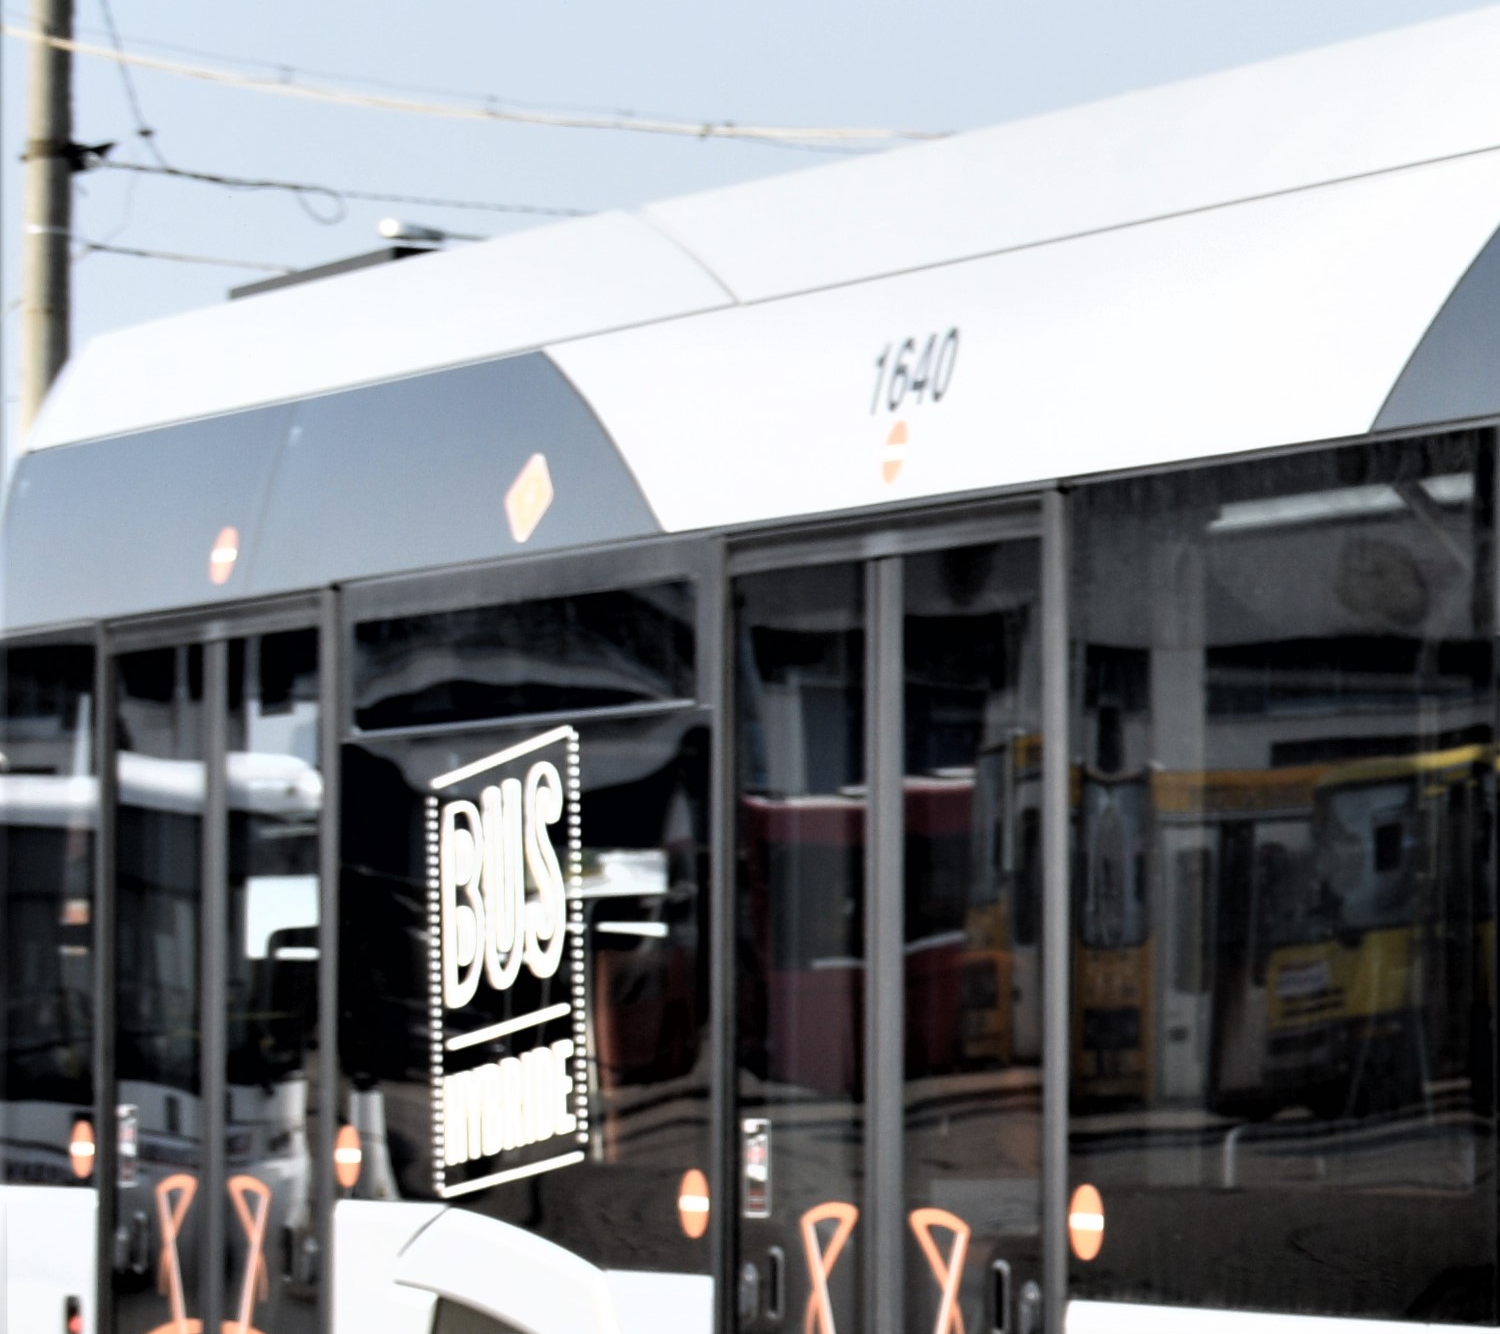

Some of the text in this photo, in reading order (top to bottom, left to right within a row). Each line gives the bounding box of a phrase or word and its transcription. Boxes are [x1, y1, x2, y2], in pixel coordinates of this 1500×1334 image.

[870, 326, 959, 416] 1640
[441, 760, 568, 1010] BUS
[443, 1038, 577, 1166] HYBRIDE
